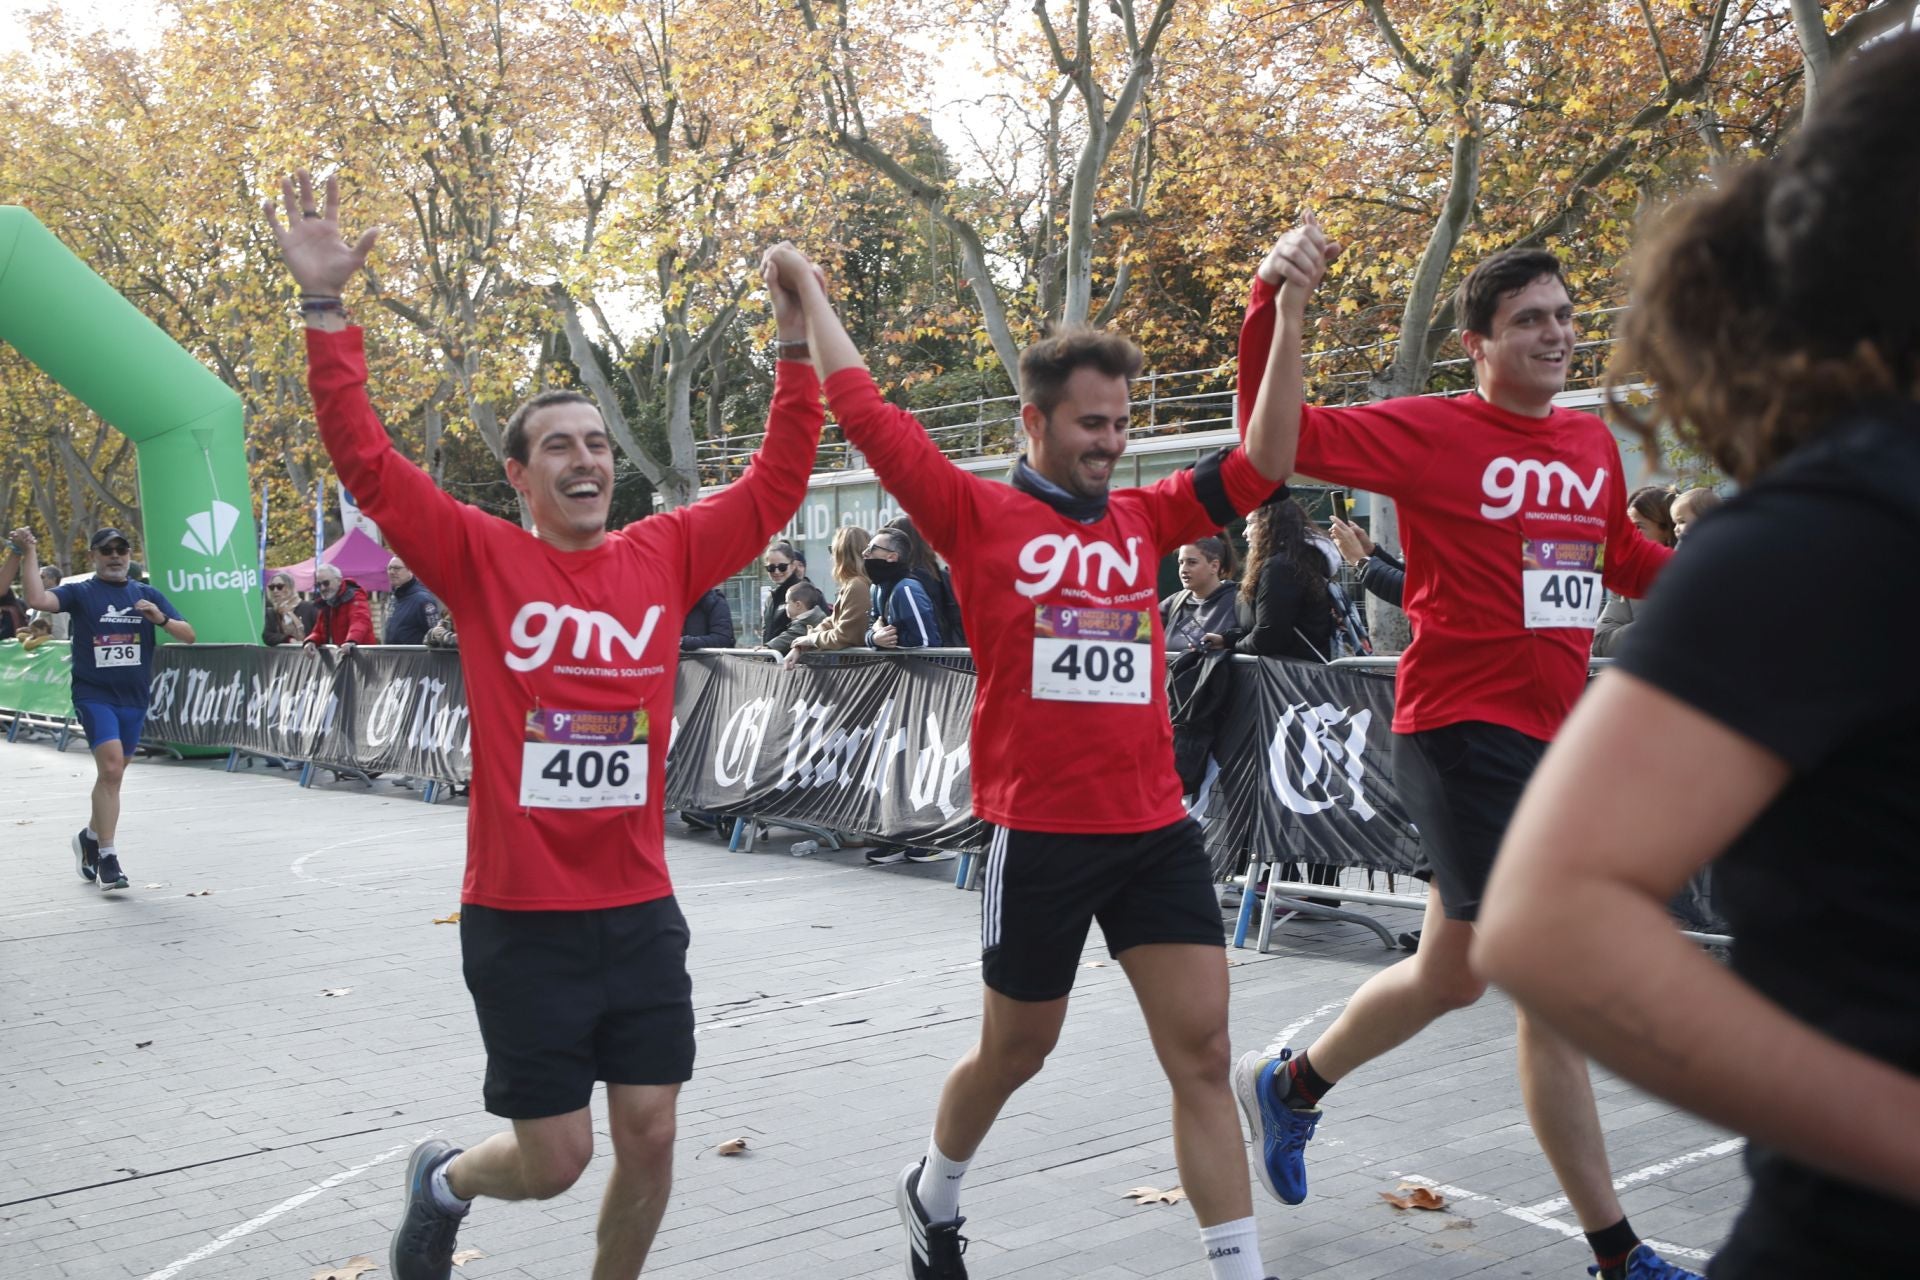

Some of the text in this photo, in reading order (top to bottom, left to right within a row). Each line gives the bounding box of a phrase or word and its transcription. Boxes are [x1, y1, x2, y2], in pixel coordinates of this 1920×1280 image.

[1481, 456, 1606, 520] gmv
[1525, 511, 1572, 523] INNOVATING
[167, 564, 257, 594] Unicaja
[1015, 533, 1139, 598] gmv
[1540, 574, 1594, 610] 407
[99, 616, 143, 624] MICHELIN
[504, 601, 665, 672] gmv
[101, 646, 135, 660] 736
[553, 665, 618, 677] INNOVATING
[1051, 644, 1135, 684] 408
[148, 667, 179, 722] El
[180, 667, 245, 726] Norte
[366, 677, 412, 747] El
[541, 749, 631, 788] 406
[714, 697, 971, 820] El Norte de
[1269, 701, 1376, 821] El
